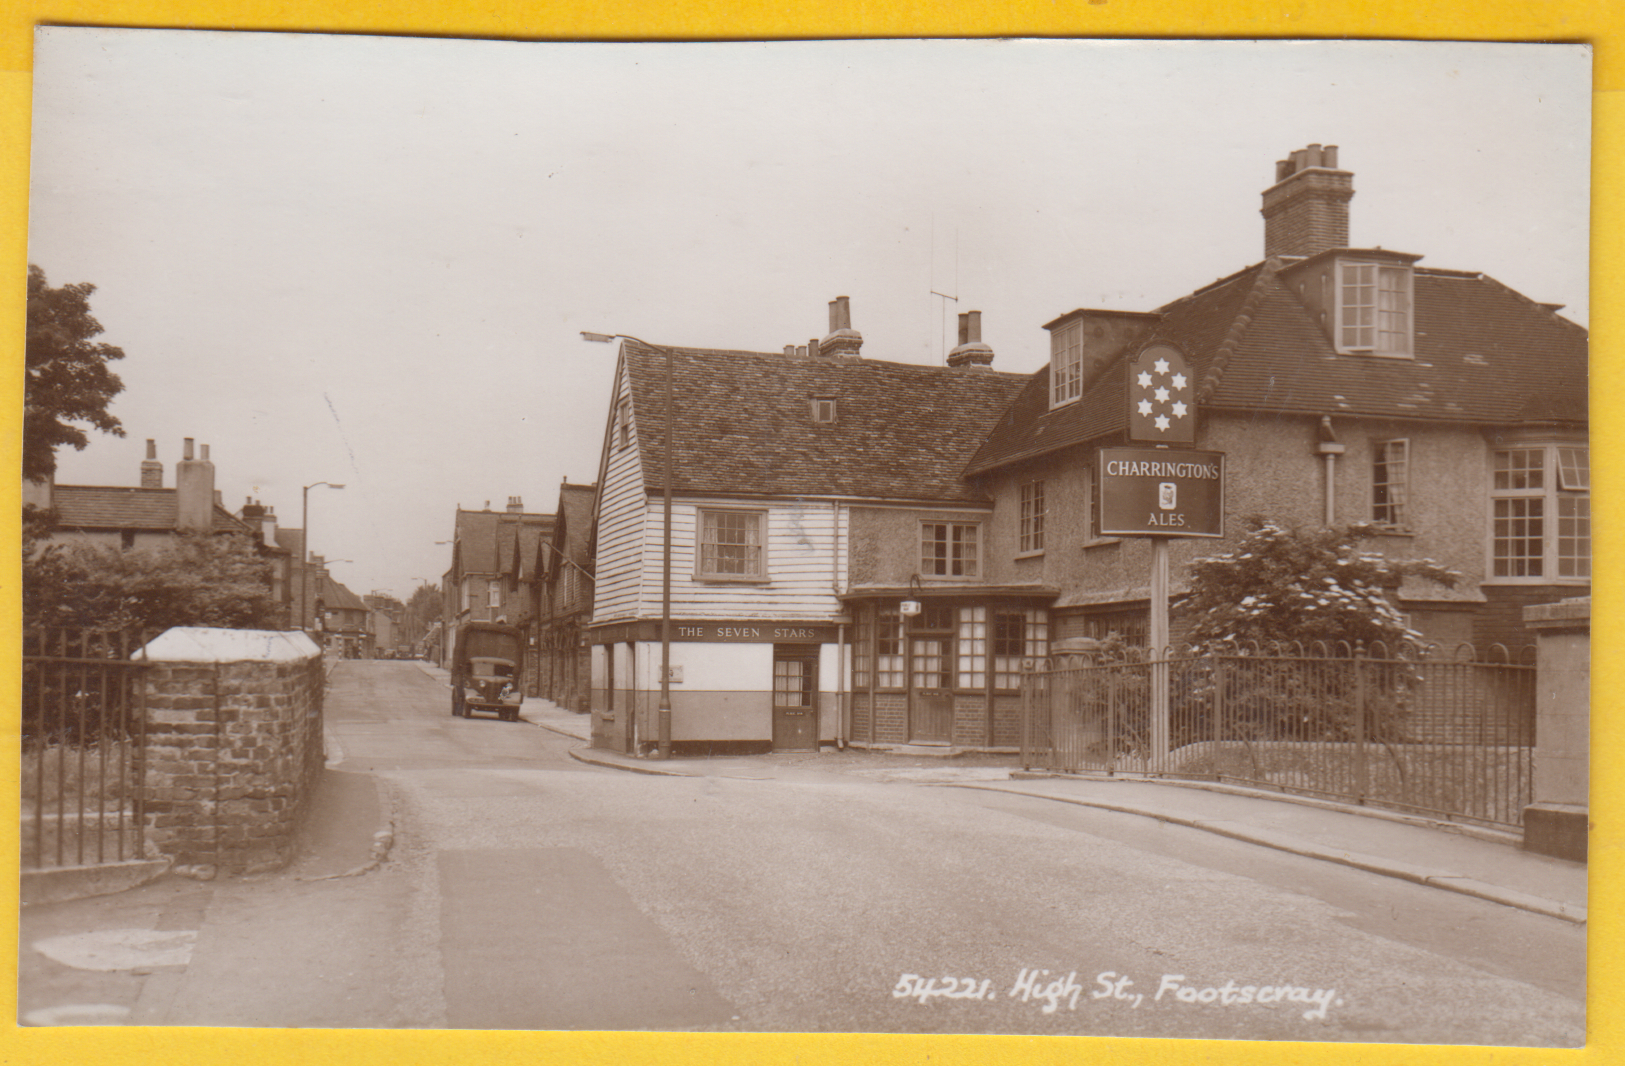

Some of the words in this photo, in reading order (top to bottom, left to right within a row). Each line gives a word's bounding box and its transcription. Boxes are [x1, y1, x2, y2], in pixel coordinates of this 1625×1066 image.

[1106, 460, 1219, 479] CHARRINGTON'S
[1147, 512, 1185, 527] ALES
[678, 626, 704, 637] THE
[717, 627, 760, 638] SEVEN
[774, 628, 815, 638] STARS
